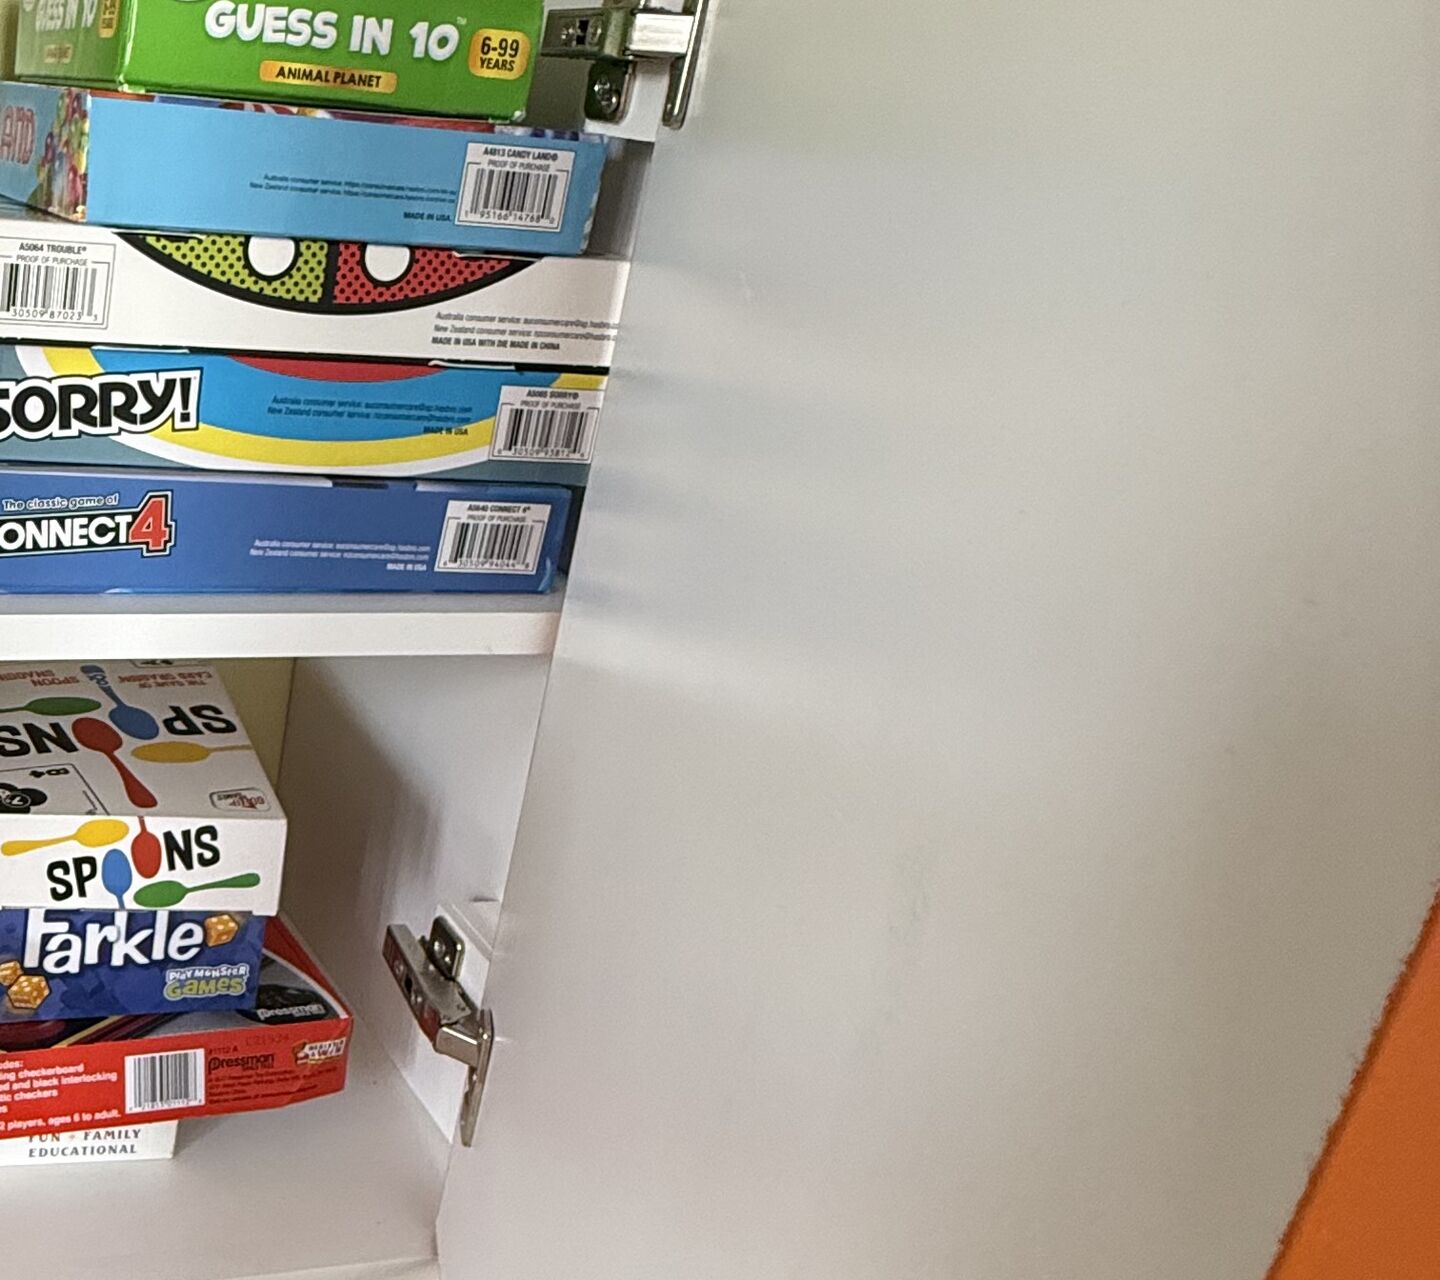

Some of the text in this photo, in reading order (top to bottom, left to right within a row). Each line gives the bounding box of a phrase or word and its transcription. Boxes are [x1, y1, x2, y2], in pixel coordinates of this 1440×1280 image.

[204, 0, 460, 61] GUESS IN 10
[480, 35, 521, 60] 6-99
[478, 57, 516, 73] YEARS
[274, 66, 383, 89] ANIMAL PLANET
[506, 149, 531, 159] CANDY
[487, 158, 551, 172] PROOF OF PURCHASE
[403, 211, 426, 221] MADE
[426, 212, 435, 221] IN
[16, 254, 89, 267] PROOF OF PURCHASE
[464, 314, 497, 323] consumer
[433, 324, 449, 333] New
[431, 336, 452, 345] MADE
[453, 337, 461, 345] IN
[462, 338, 477, 346] USA
[477, 338, 496, 348] WITH
[509, 340, 529, 349] MADE
[530, 341, 539, 349] IN
[539, 341, 560, 350] CHINA
[445, 426, 453, 435] IN
[3, 493, 119, 511] The classic game of
[128, 496, 171, 551] 4
[30, 676, 80, 687] SPOON
[23, 908, 204, 974] Farkle
[18, 1063, 85, 1079] checkerboard
[12, 1080, 31, 1090] and
[32, 1078, 59, 1088] black
[60, 1072, 118, 1085] interlocking
[13, 1089, 58, 1101] checkers
[48, 1115, 71, 1127] ages
[81, 1112, 92, 1121] to
[83, 1129, 141, 1141] FAMILY
[28, 1144, 137, 1158] EDUCATIONAL
